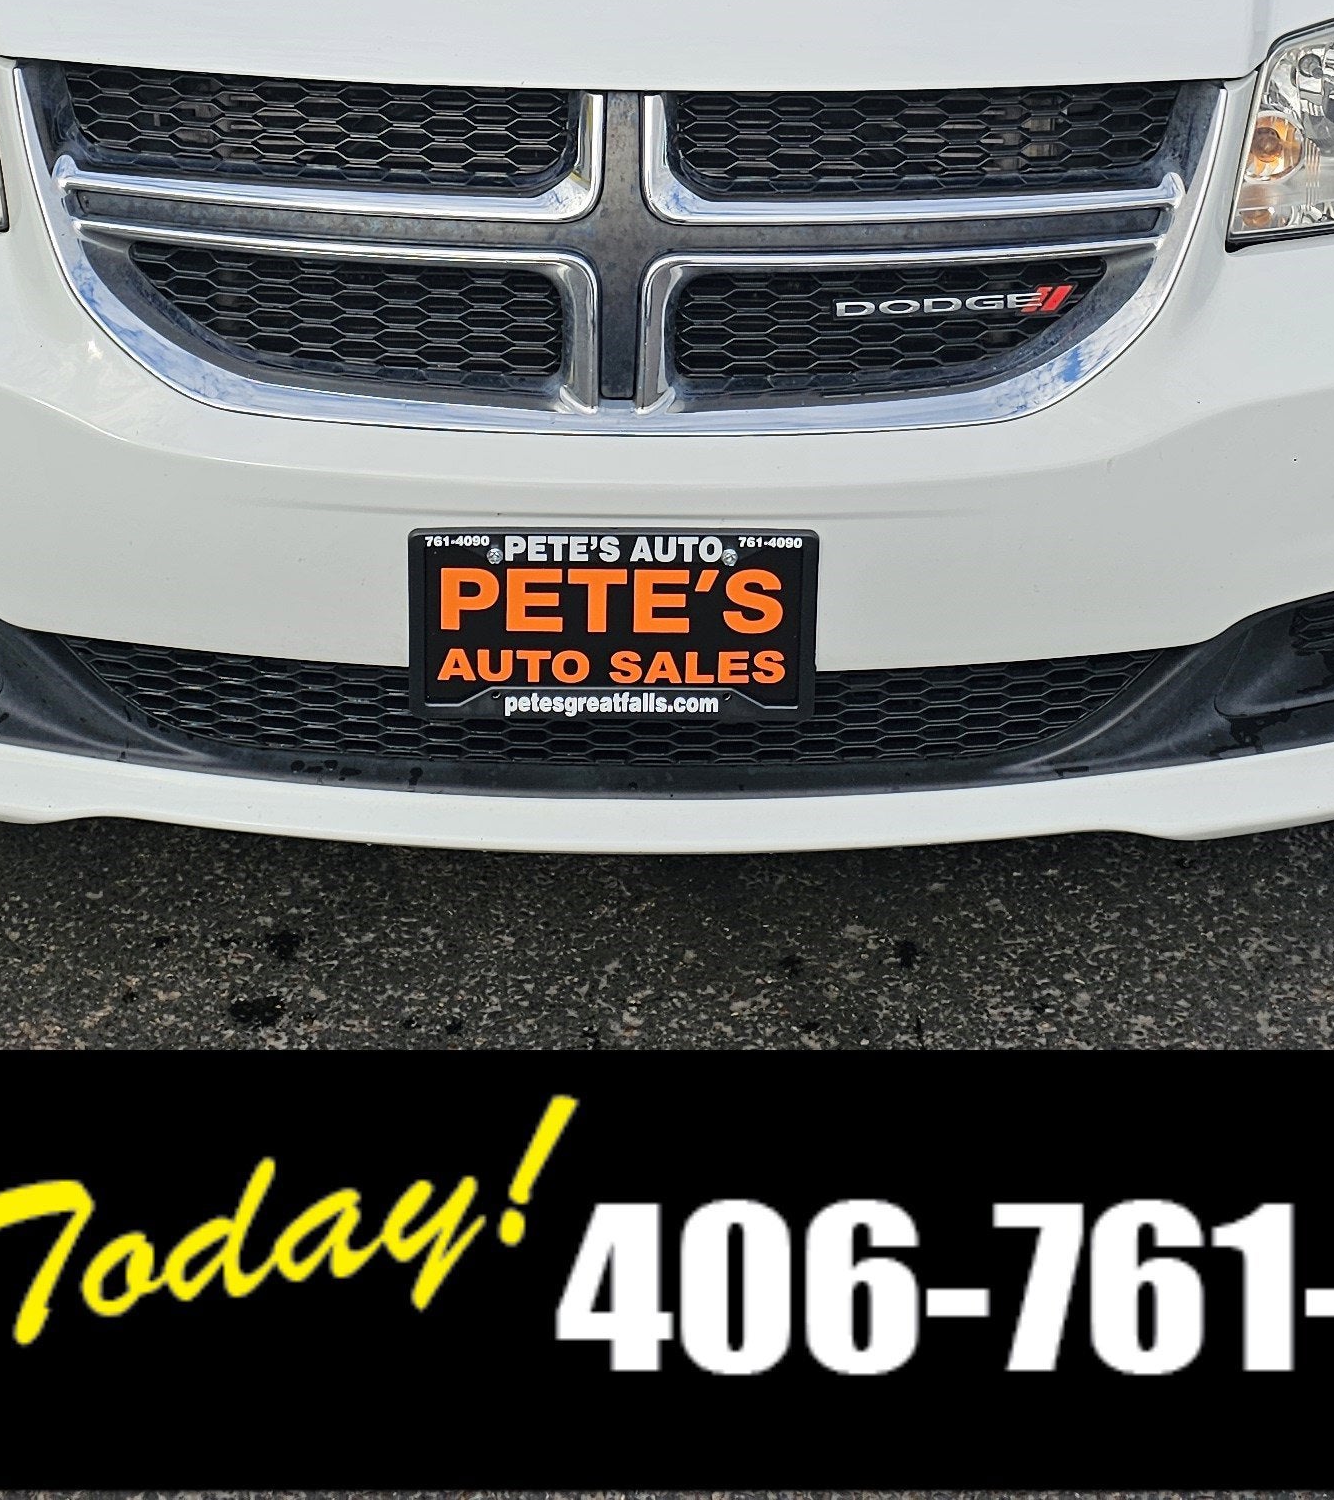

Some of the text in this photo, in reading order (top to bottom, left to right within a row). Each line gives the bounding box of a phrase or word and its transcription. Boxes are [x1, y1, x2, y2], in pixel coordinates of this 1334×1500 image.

[836, 293, 1043, 318] DODGE
[424, 535, 491, 548] 761-4090
[504, 535, 723, 564] PETE'S AUTO
[738, 536, 803, 549] 761-4090
[440, 567, 784, 635] PETE'S
[437, 648, 786, 685] AUTO SALES
[504, 691, 720, 717] petesgreatfalls.com
